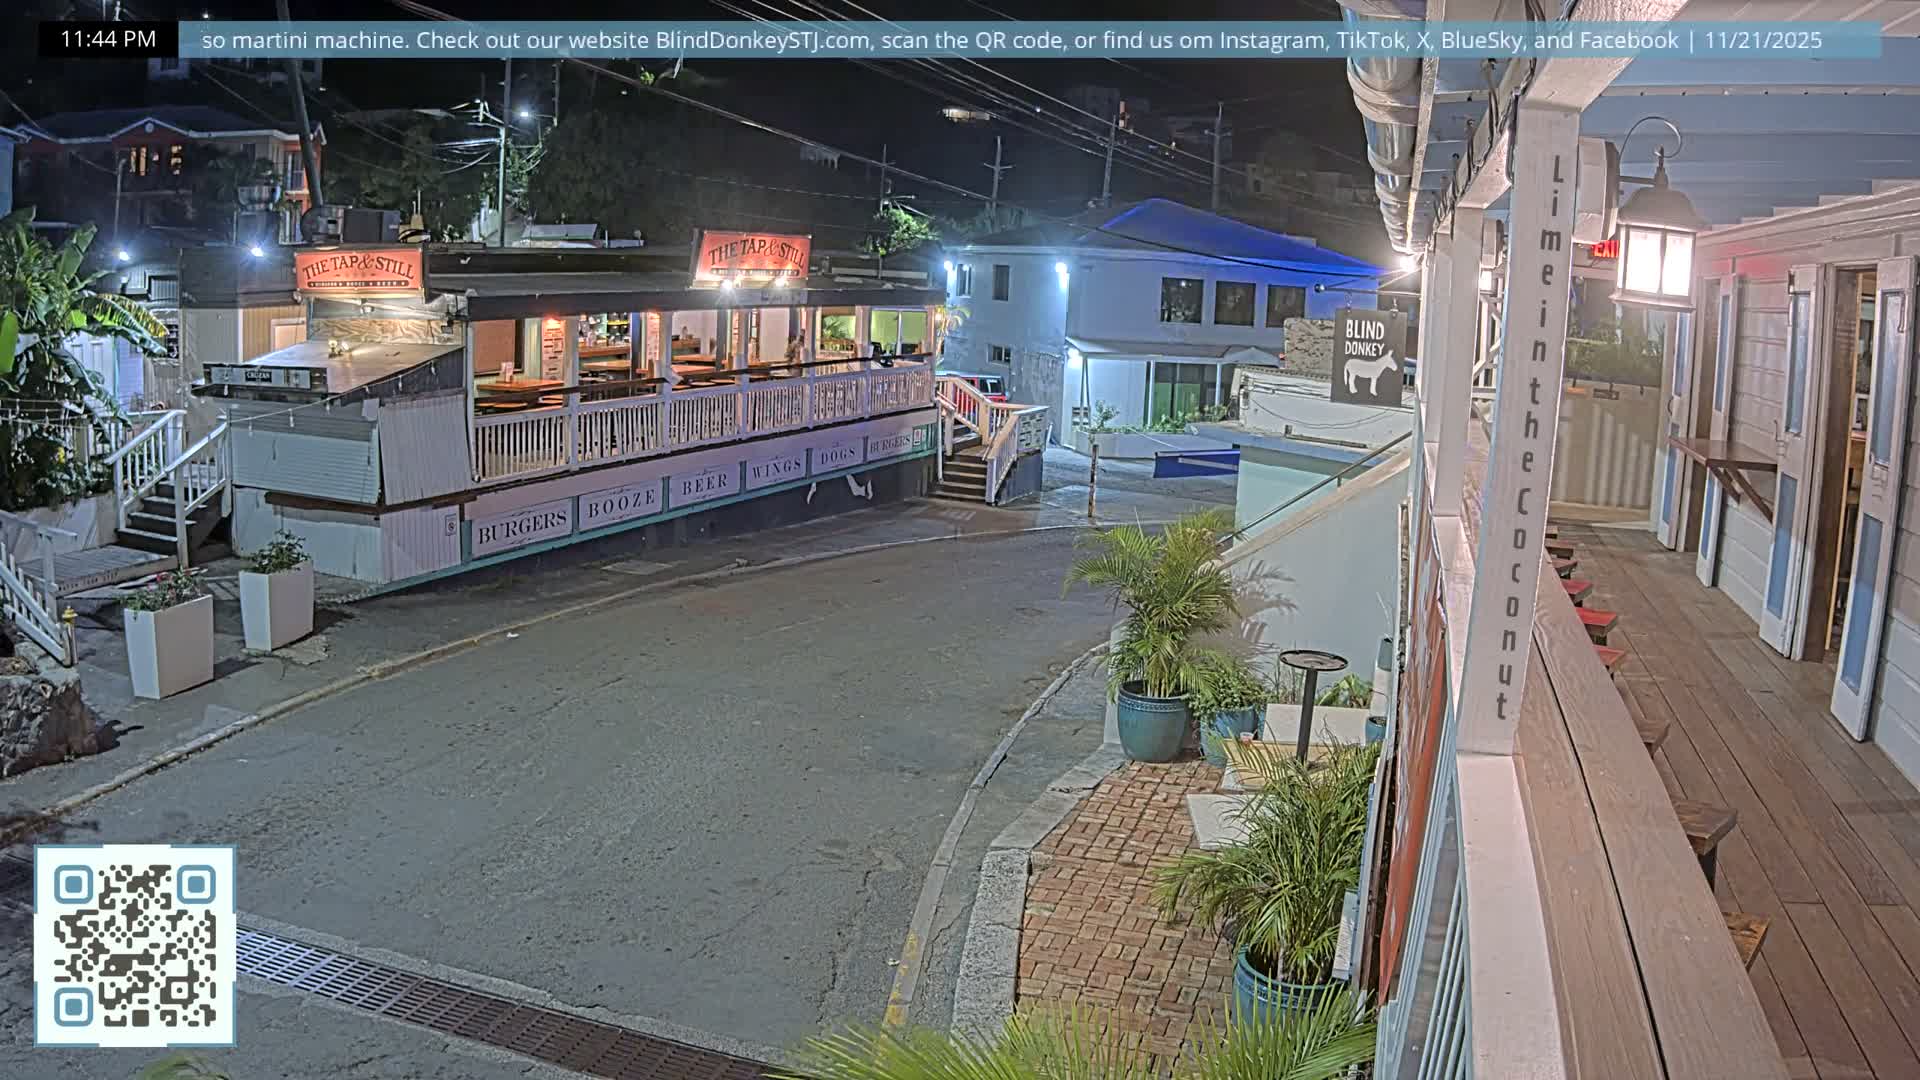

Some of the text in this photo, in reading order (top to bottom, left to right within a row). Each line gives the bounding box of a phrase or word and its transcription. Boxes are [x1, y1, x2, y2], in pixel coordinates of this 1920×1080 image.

[709, 238, 805, 269] THE TAP & STILL
[303, 254, 414, 280] THE TAP & STILL
[1346, 319, 1385, 340] BLIND
[1344, 341, 1385, 357] DONKEY
[870, 434, 911, 454] BURGERS
[820, 447, 856, 465] DOGS
[752, 457, 802, 480] WINGS
[682, 472, 728, 496] BEER
[588, 488, 655, 519] BOOZE
[478, 510, 567, 545] BURGERS
